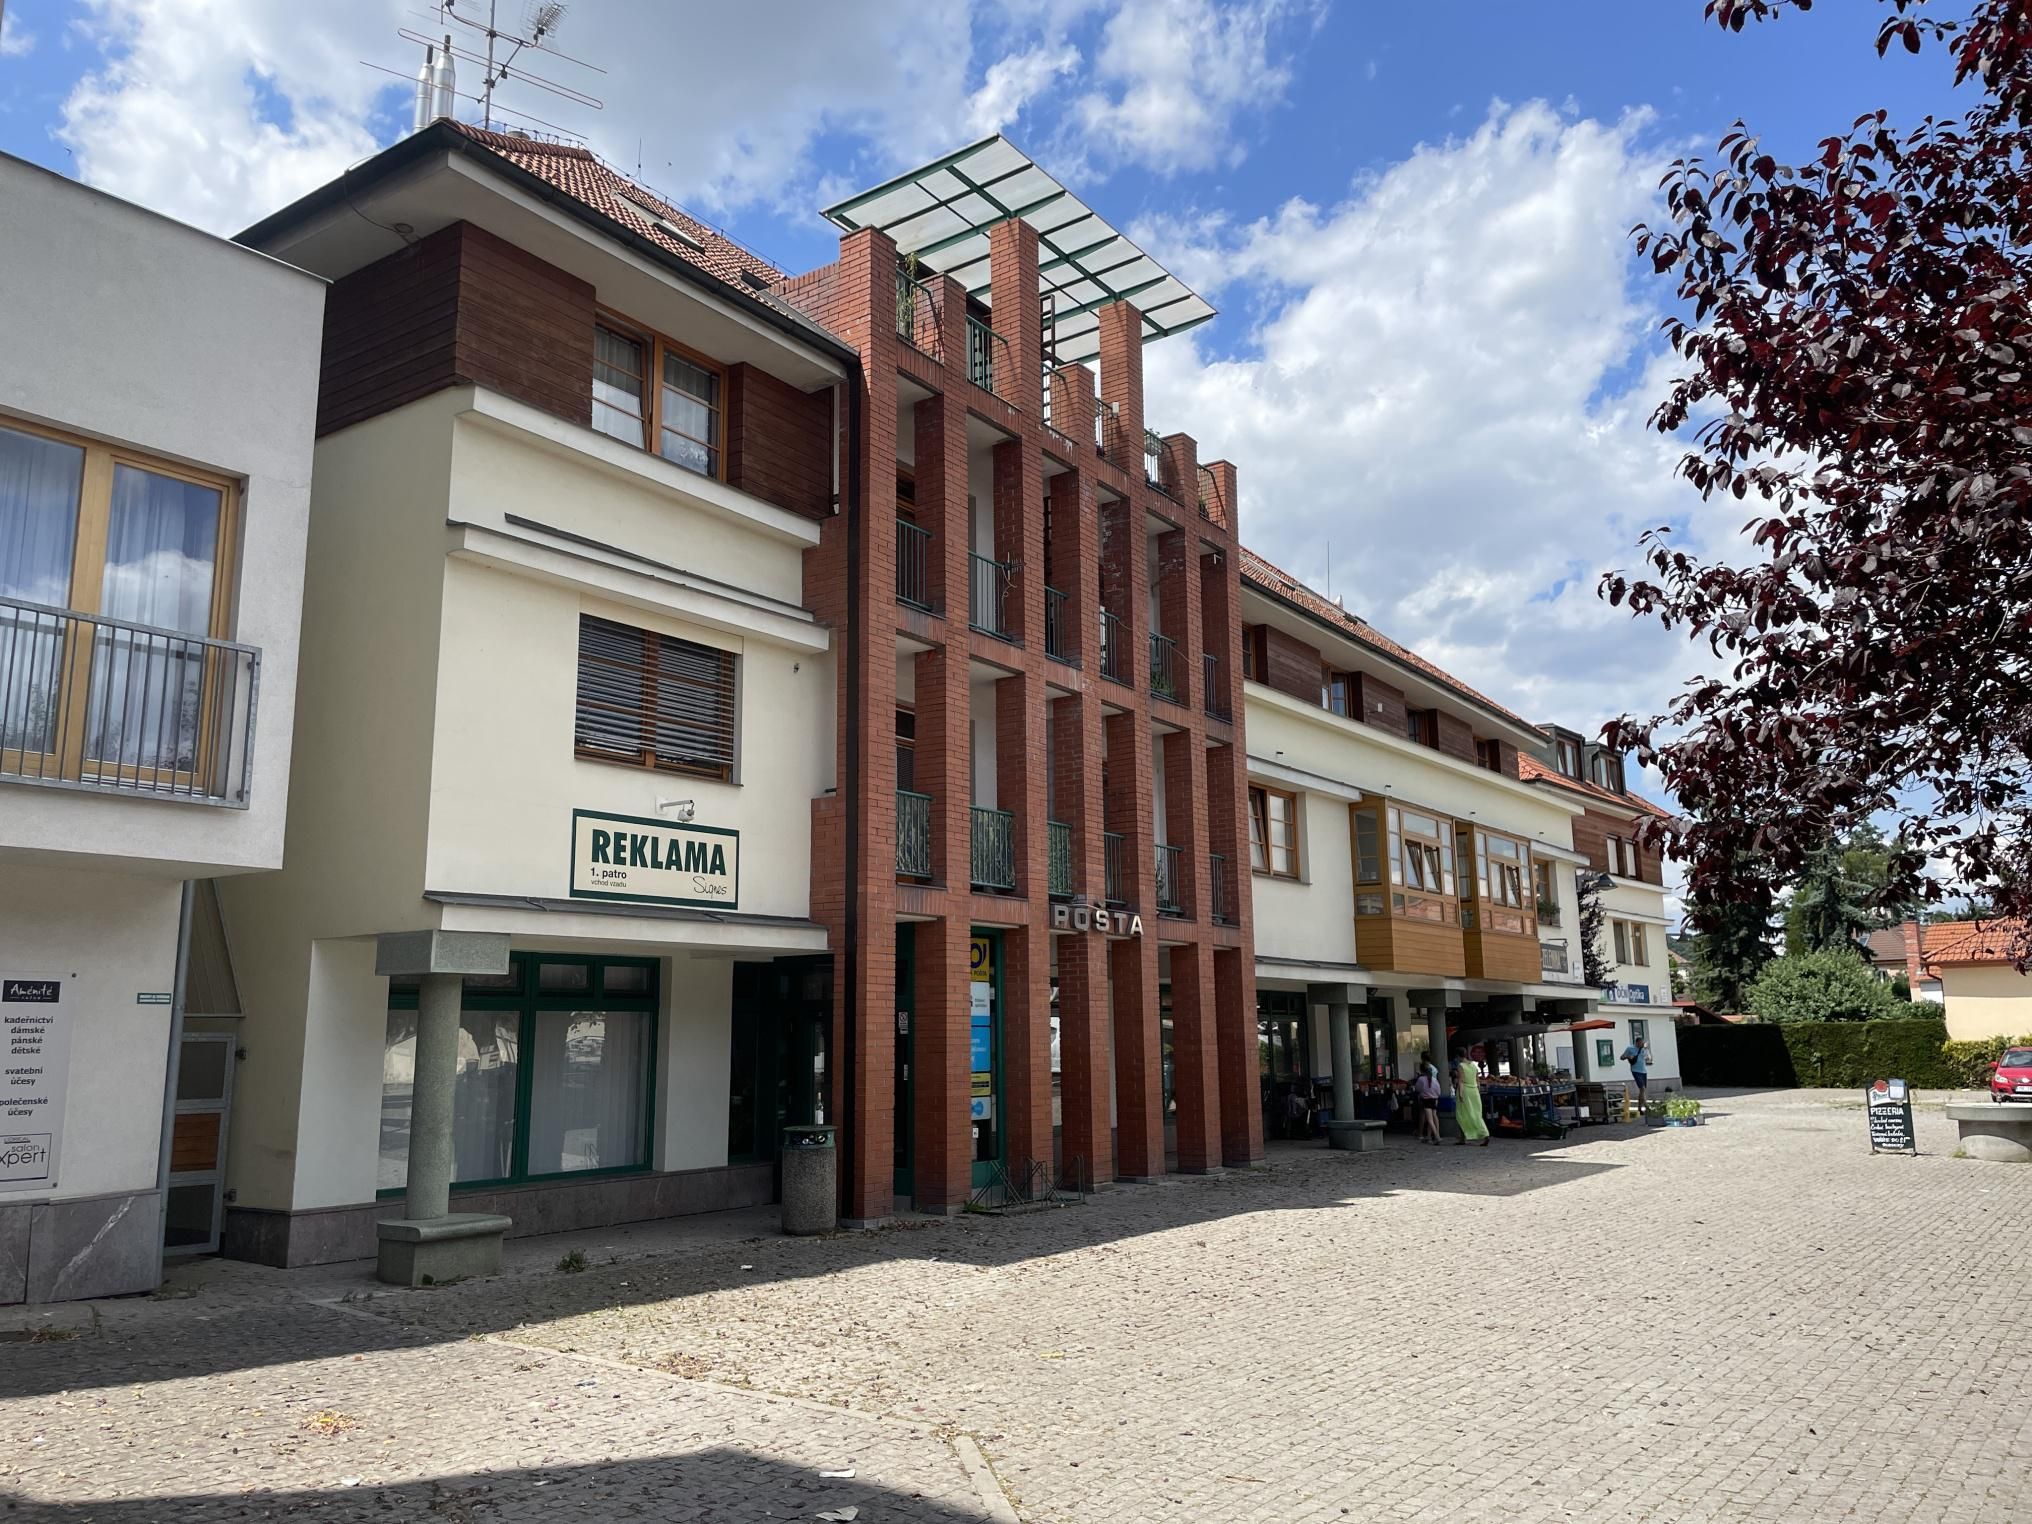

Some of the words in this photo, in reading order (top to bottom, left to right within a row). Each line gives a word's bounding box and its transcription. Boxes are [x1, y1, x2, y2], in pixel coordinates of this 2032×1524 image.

[591, 829, 727, 876] REKLAMA
[590, 867, 599, 877] 1.
[602, 869, 627, 880] patro
[591, 879, 609, 887] vchod
[609, 880, 627, 888] vzadu
[1054, 901, 1145, 936] POŠTA
[4, 1015, 54, 1024] kadeřnictví
[10, 1026, 46, 1034] dámské
[11, 1035, 43, 1046] pánské
[11, 1046, 41, 1054] dětské
[5, 1067, 43, 1075] svatební
[10, 1077, 36, 1086] účesy
[8, 1107, 33, 1117] účesy
[1870, 1107, 1904, 1115] PIZZERIA
[11, 1143, 40, 1153] salon
